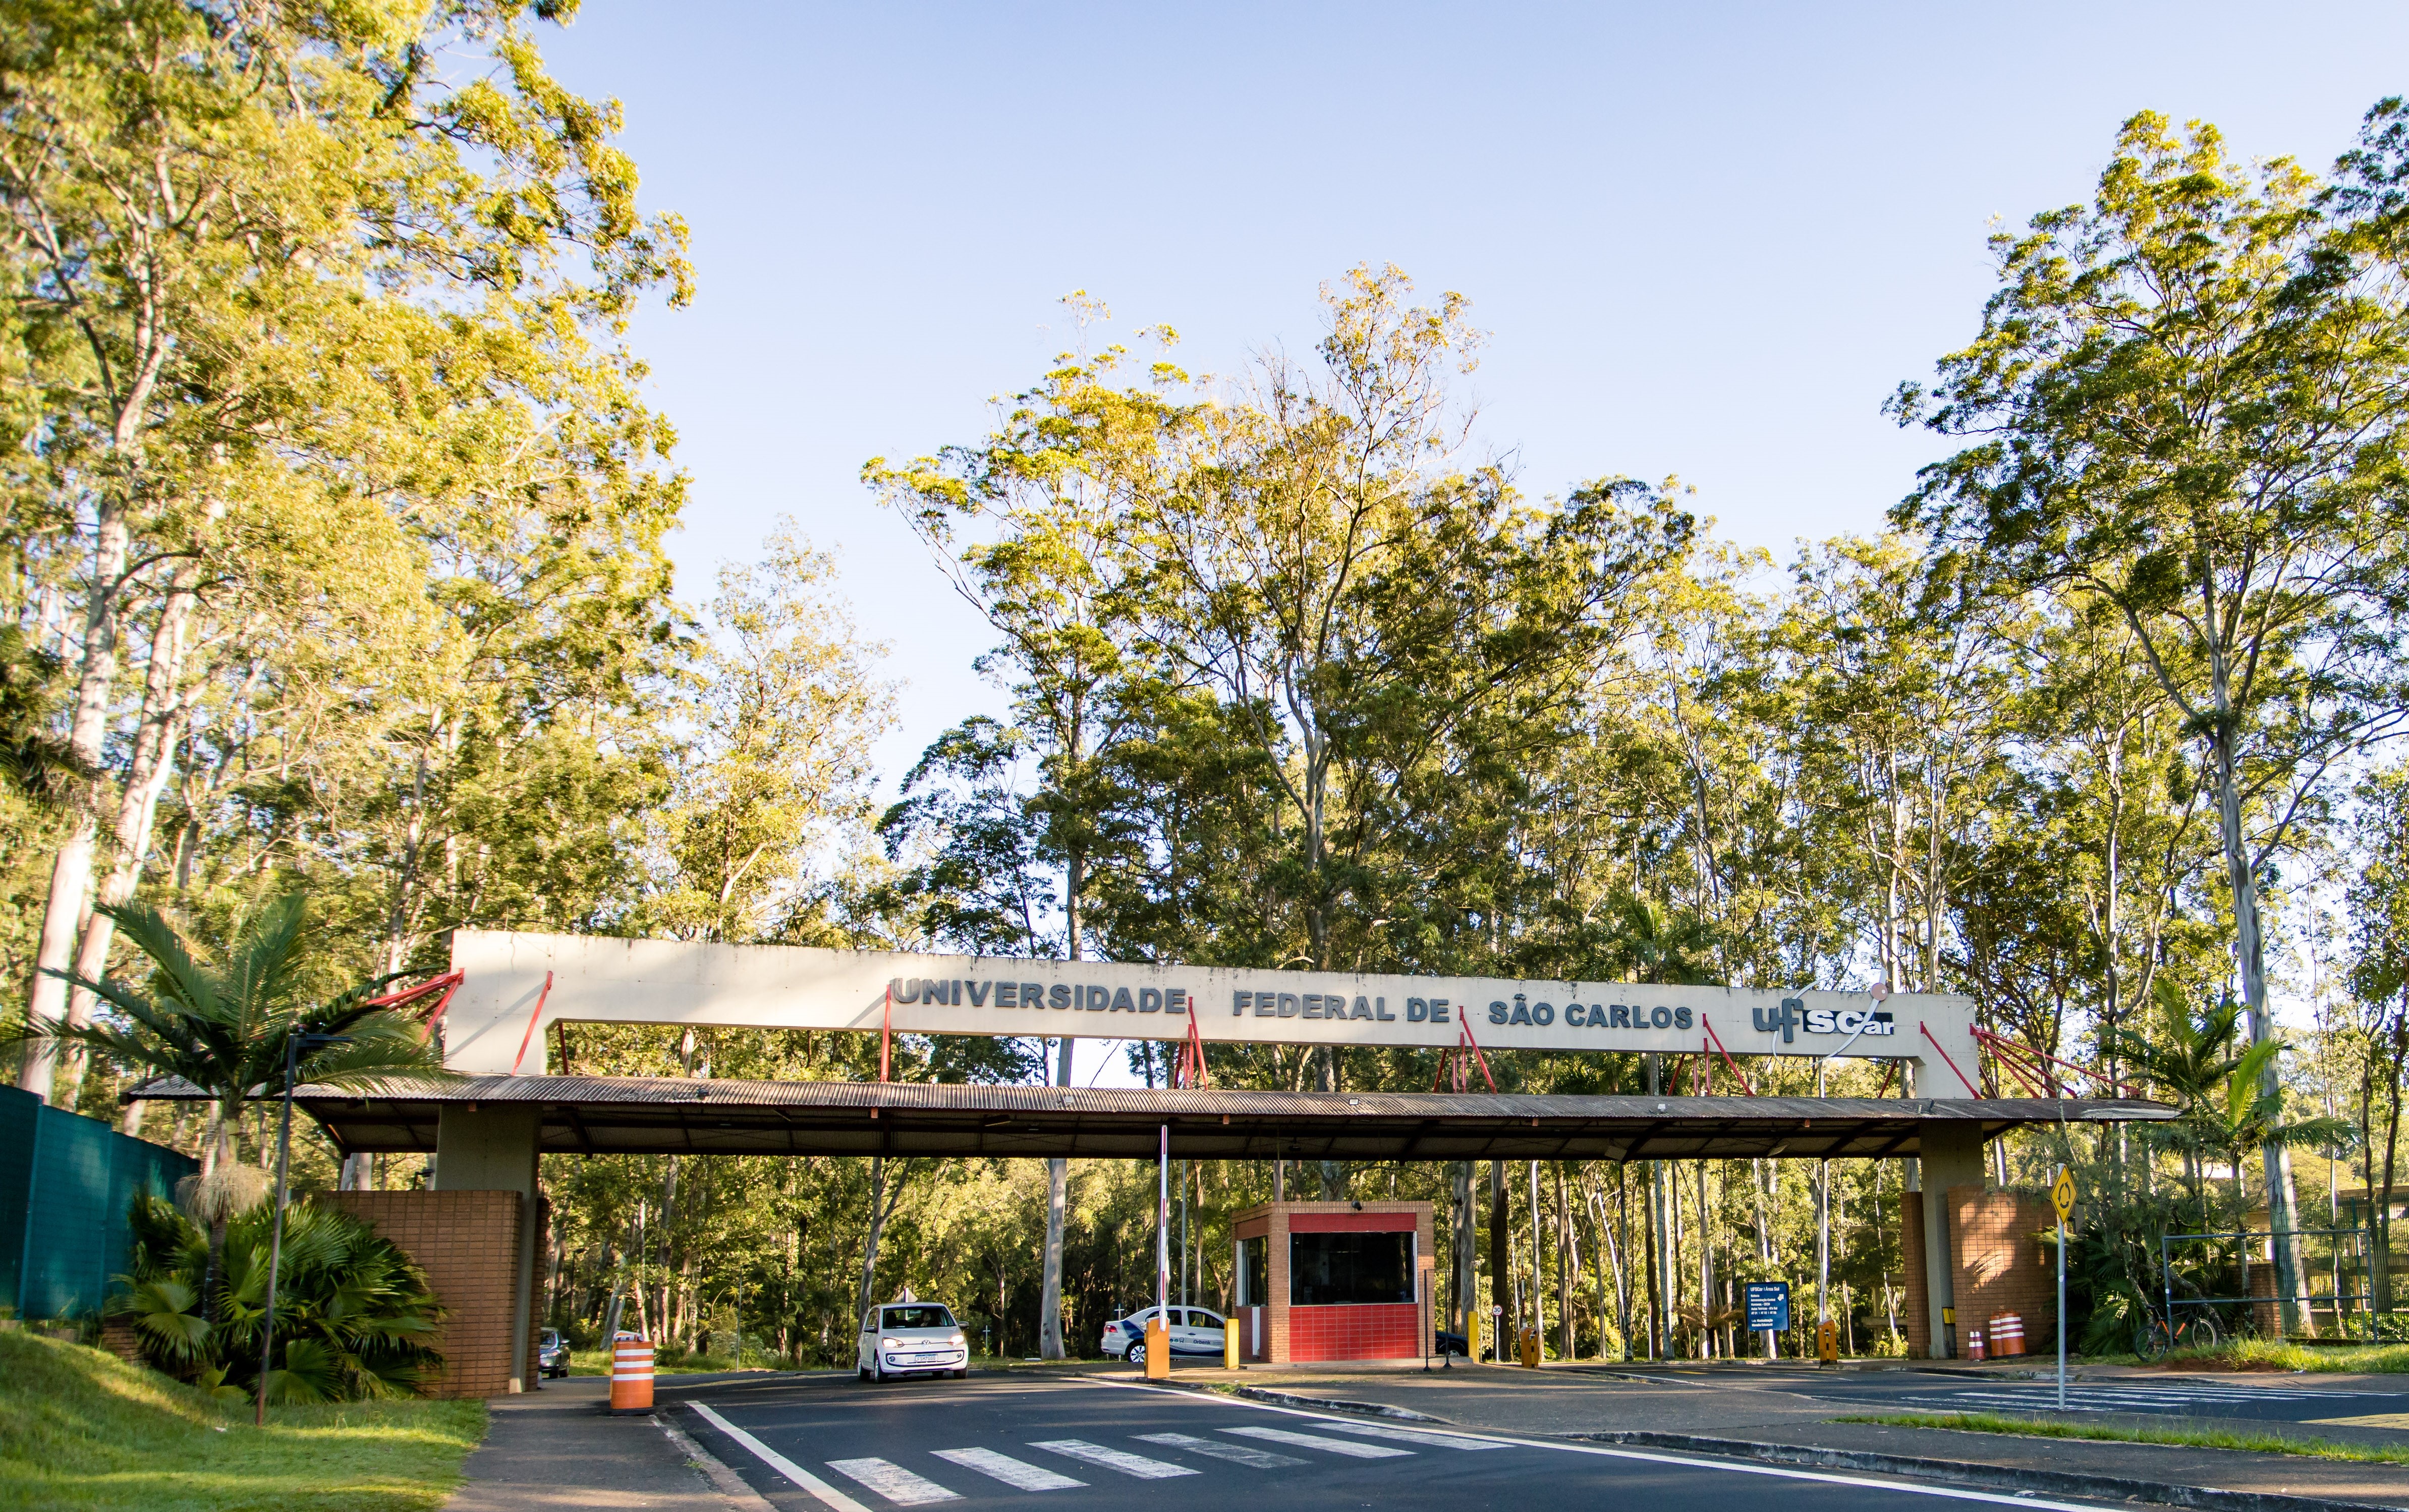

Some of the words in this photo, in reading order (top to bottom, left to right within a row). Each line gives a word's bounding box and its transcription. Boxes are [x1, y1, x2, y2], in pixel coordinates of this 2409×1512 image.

[889, 978, 1186, 1013] UNIVERSIDADE
[1233, 990, 1395, 1020] FEDERAL
[1407, 997, 1450, 1022] DE
[1488, 993, 1554, 1026] SÃO
[1564, 1003, 1693, 1029] CARLOS
